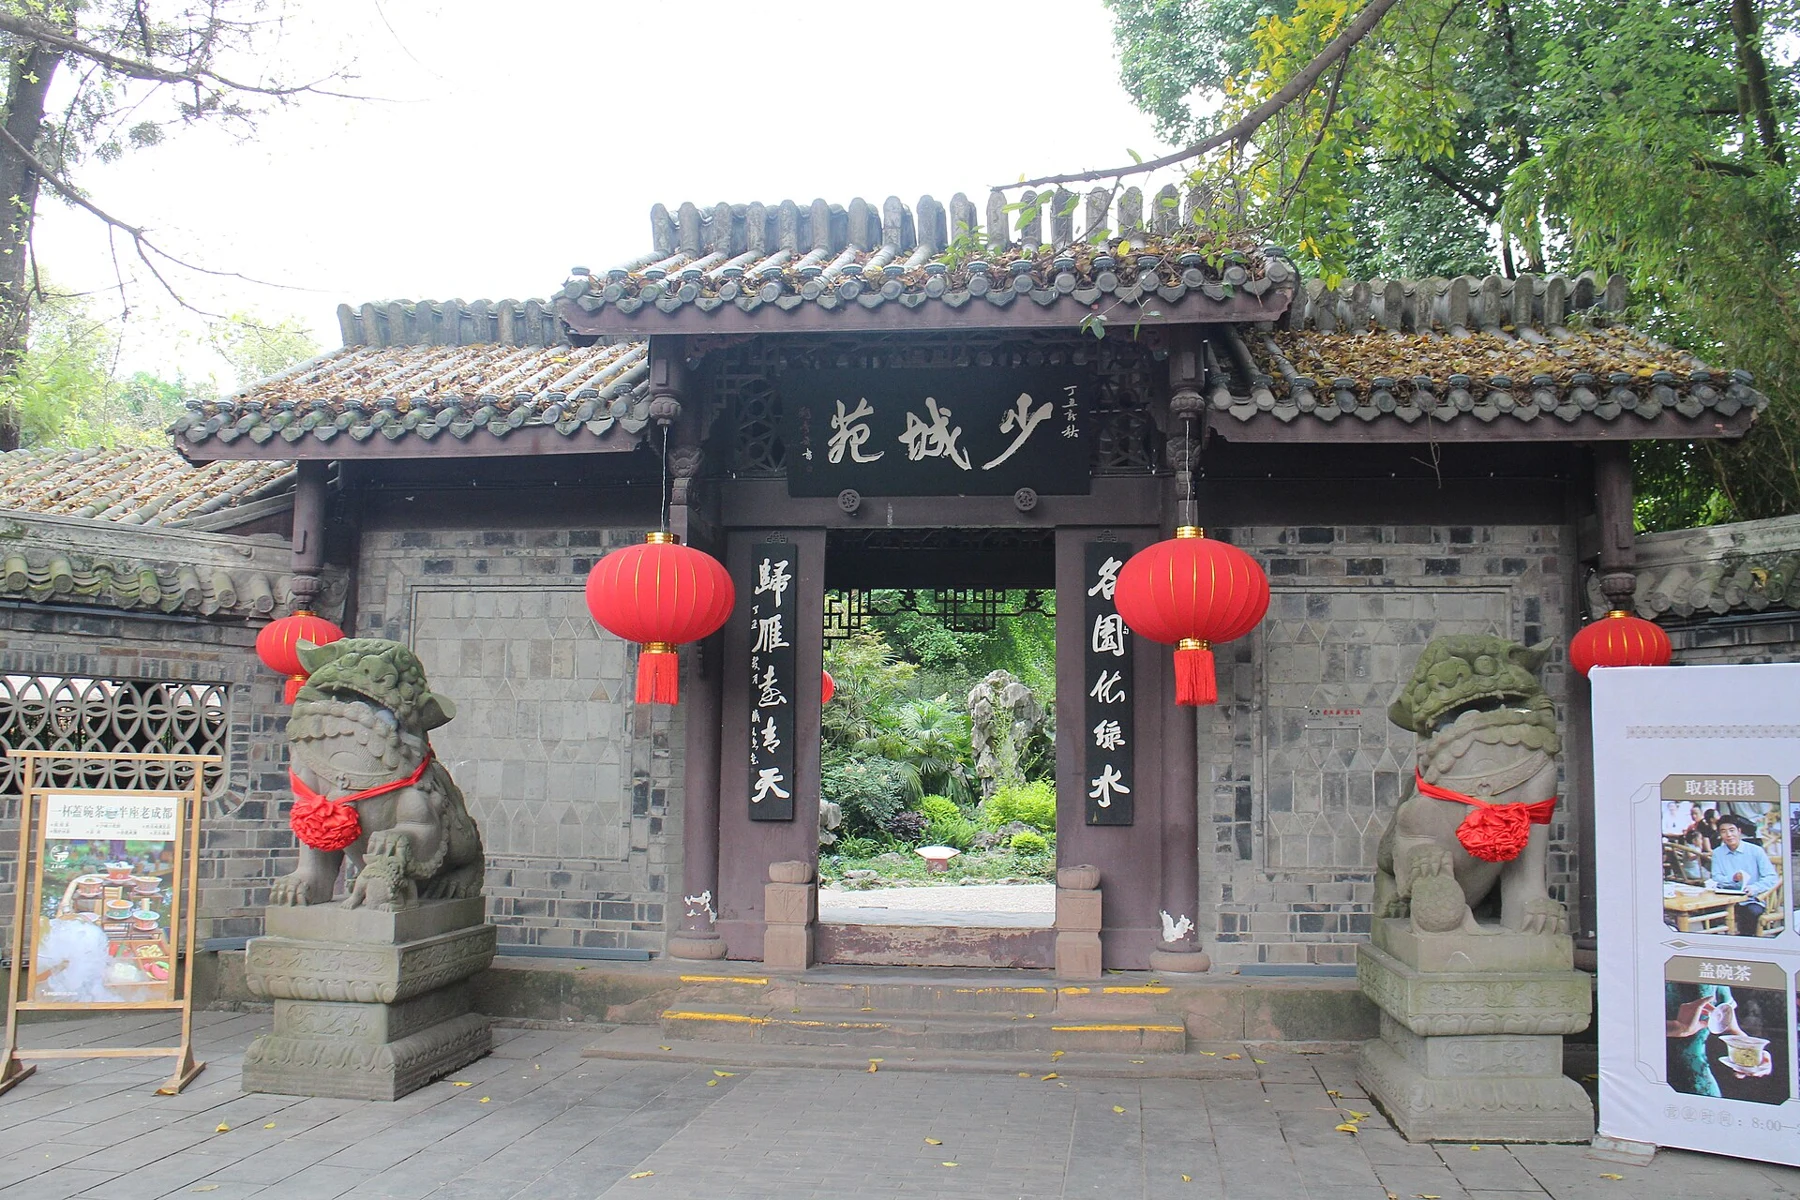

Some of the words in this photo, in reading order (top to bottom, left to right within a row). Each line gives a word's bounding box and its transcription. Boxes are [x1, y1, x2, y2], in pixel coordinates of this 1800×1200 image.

[828, 393, 1053, 471] 少城苑
[1684, 779, 1755, 796] 取景拍摄
[119, 806, 173, 819] 半座老成都
[1697, 962, 1752, 982] 盖碗茶
